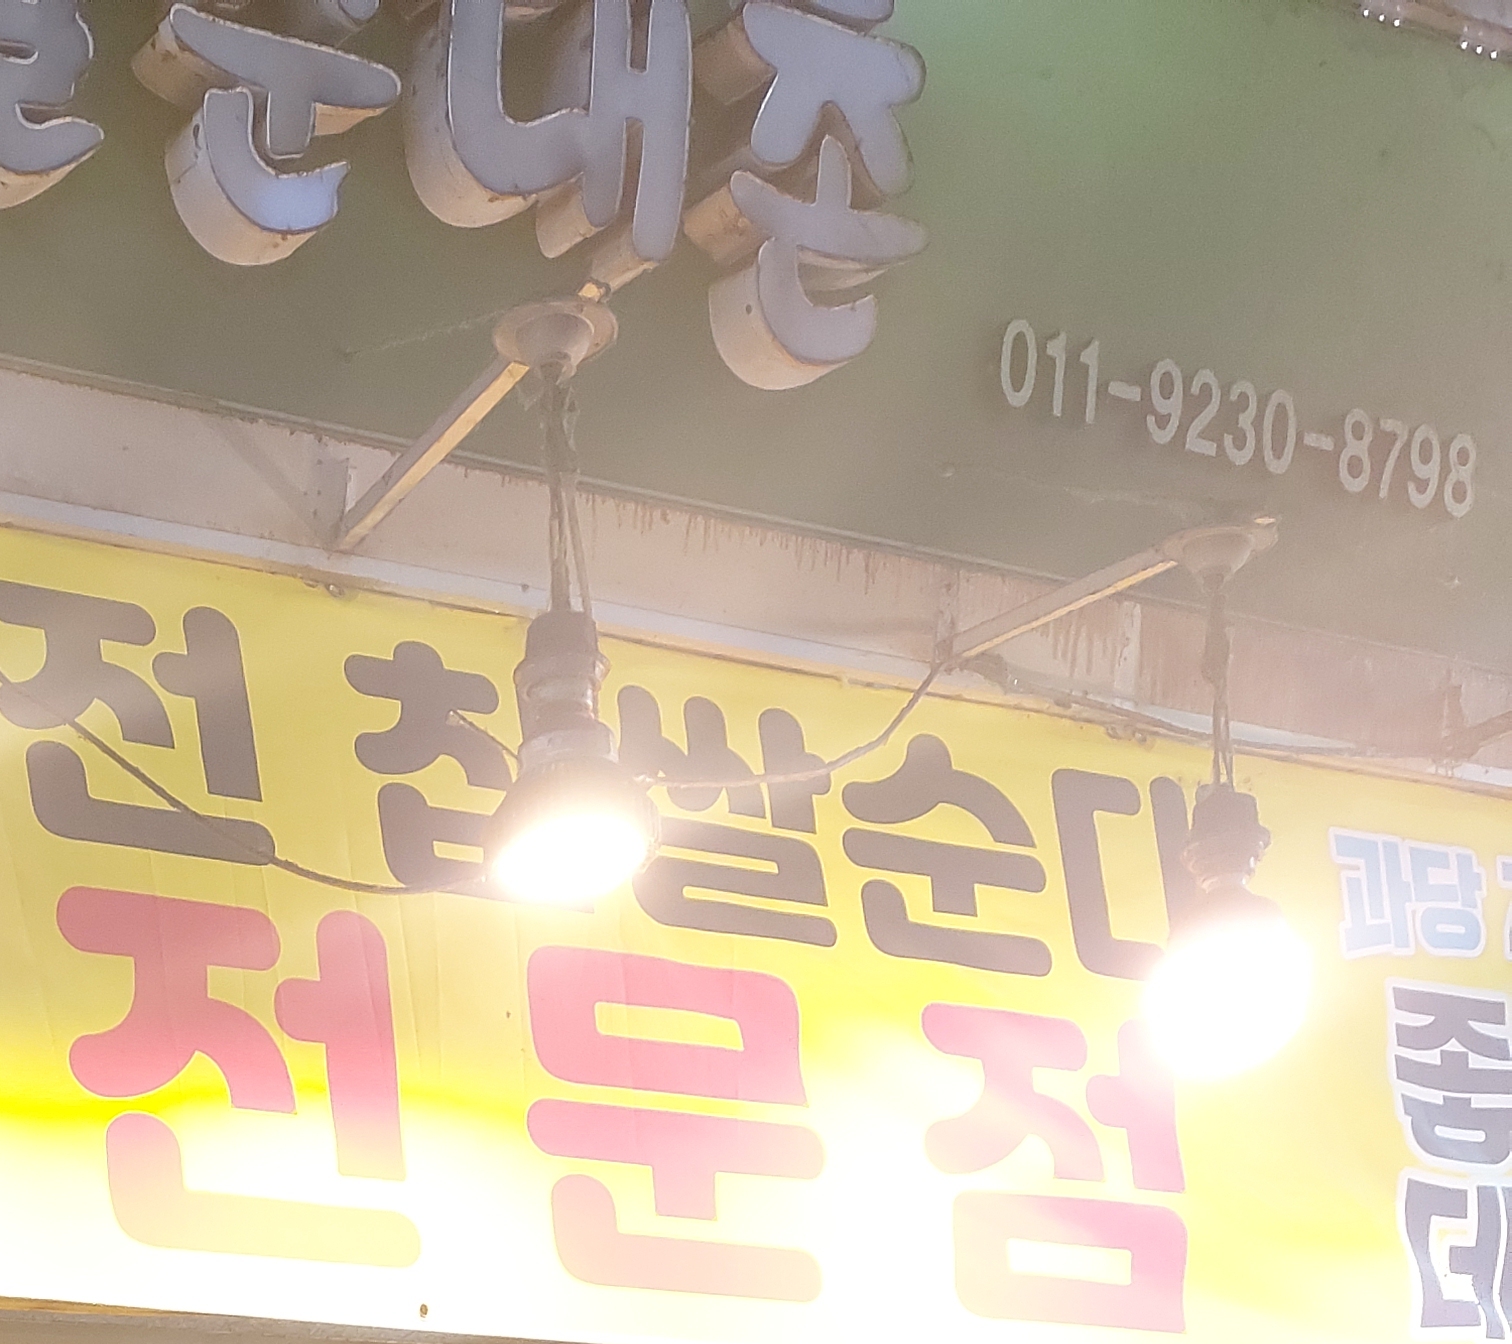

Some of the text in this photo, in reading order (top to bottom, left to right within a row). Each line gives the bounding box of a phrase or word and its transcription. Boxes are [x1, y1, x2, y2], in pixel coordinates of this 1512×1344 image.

[1000, 318, 1476, 518] 011-9230-8798
[1335, 832, 1482, 954] 과당
[55, 886, 1188, 1333] 전문점
